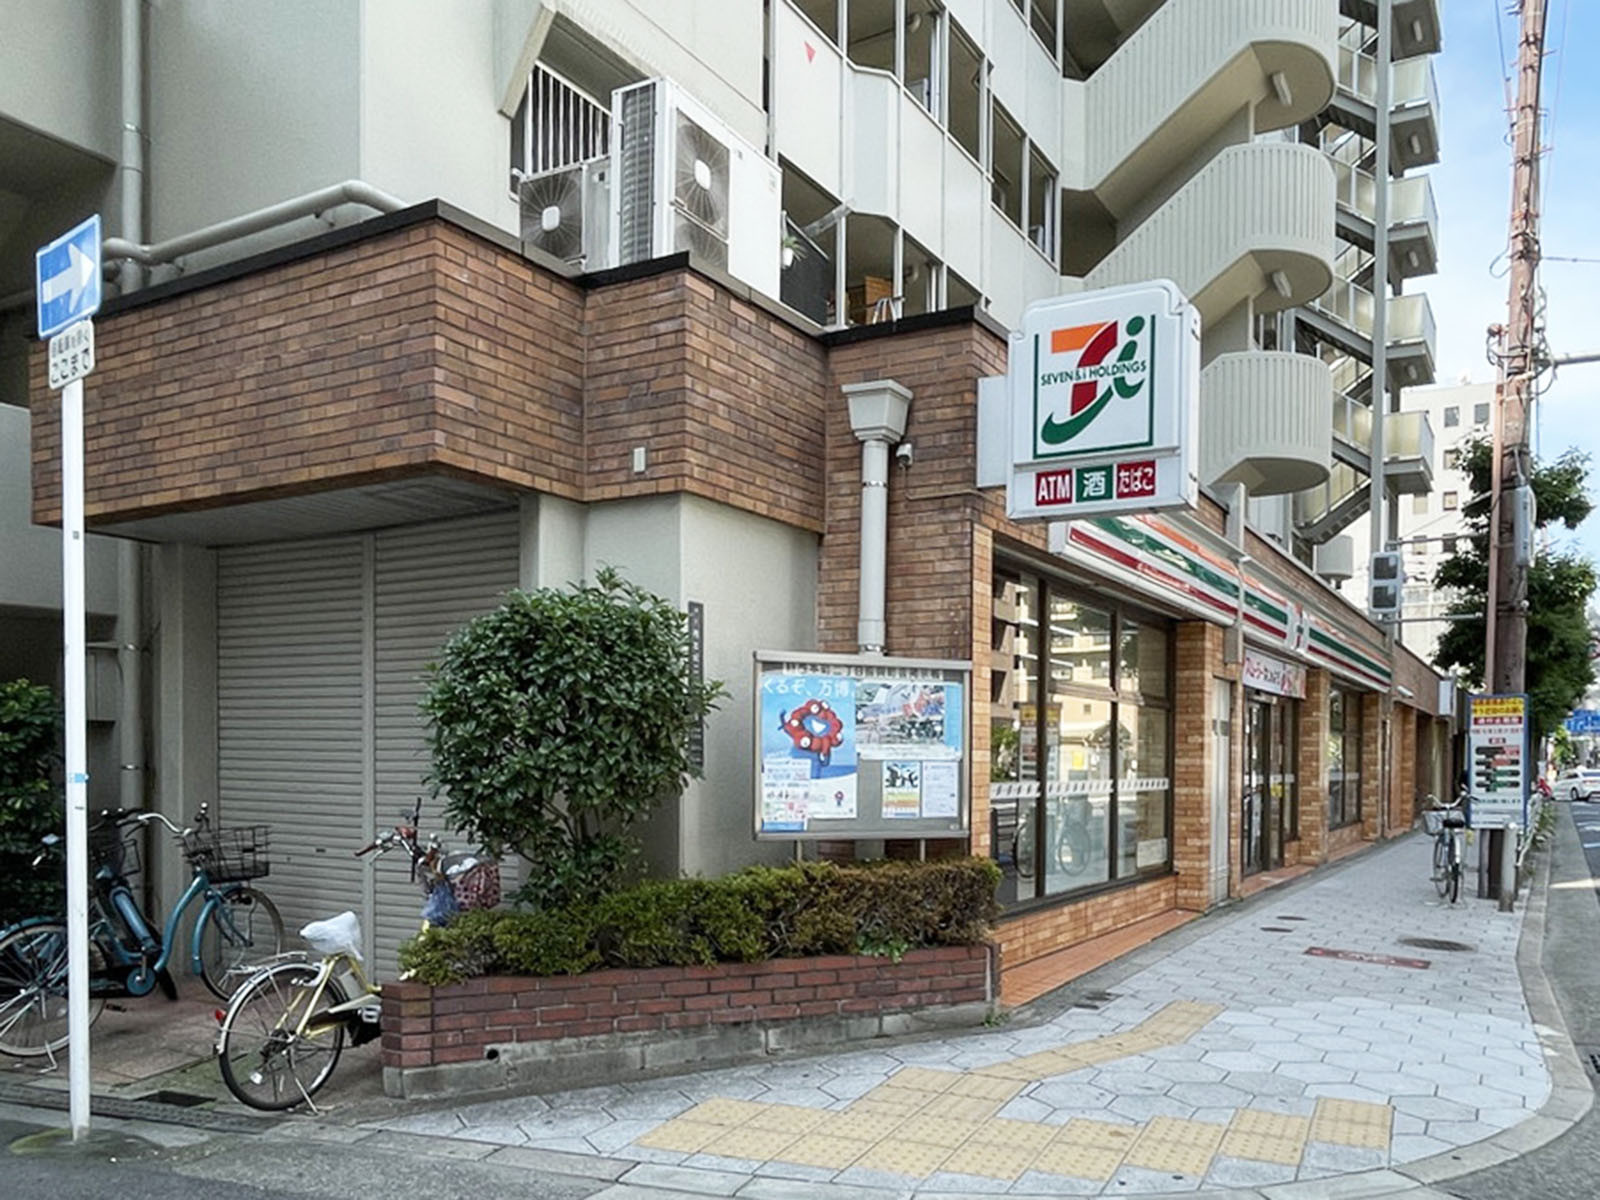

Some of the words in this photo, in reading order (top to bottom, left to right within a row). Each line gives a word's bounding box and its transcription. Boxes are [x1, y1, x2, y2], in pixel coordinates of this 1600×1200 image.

[1088, 360, 1148, 380] HOLDINGS
[1037, 477, 1071, 501] ATM
[1082, 472, 1106, 497] 酒
[1117, 467, 1155, 493] たばこ
